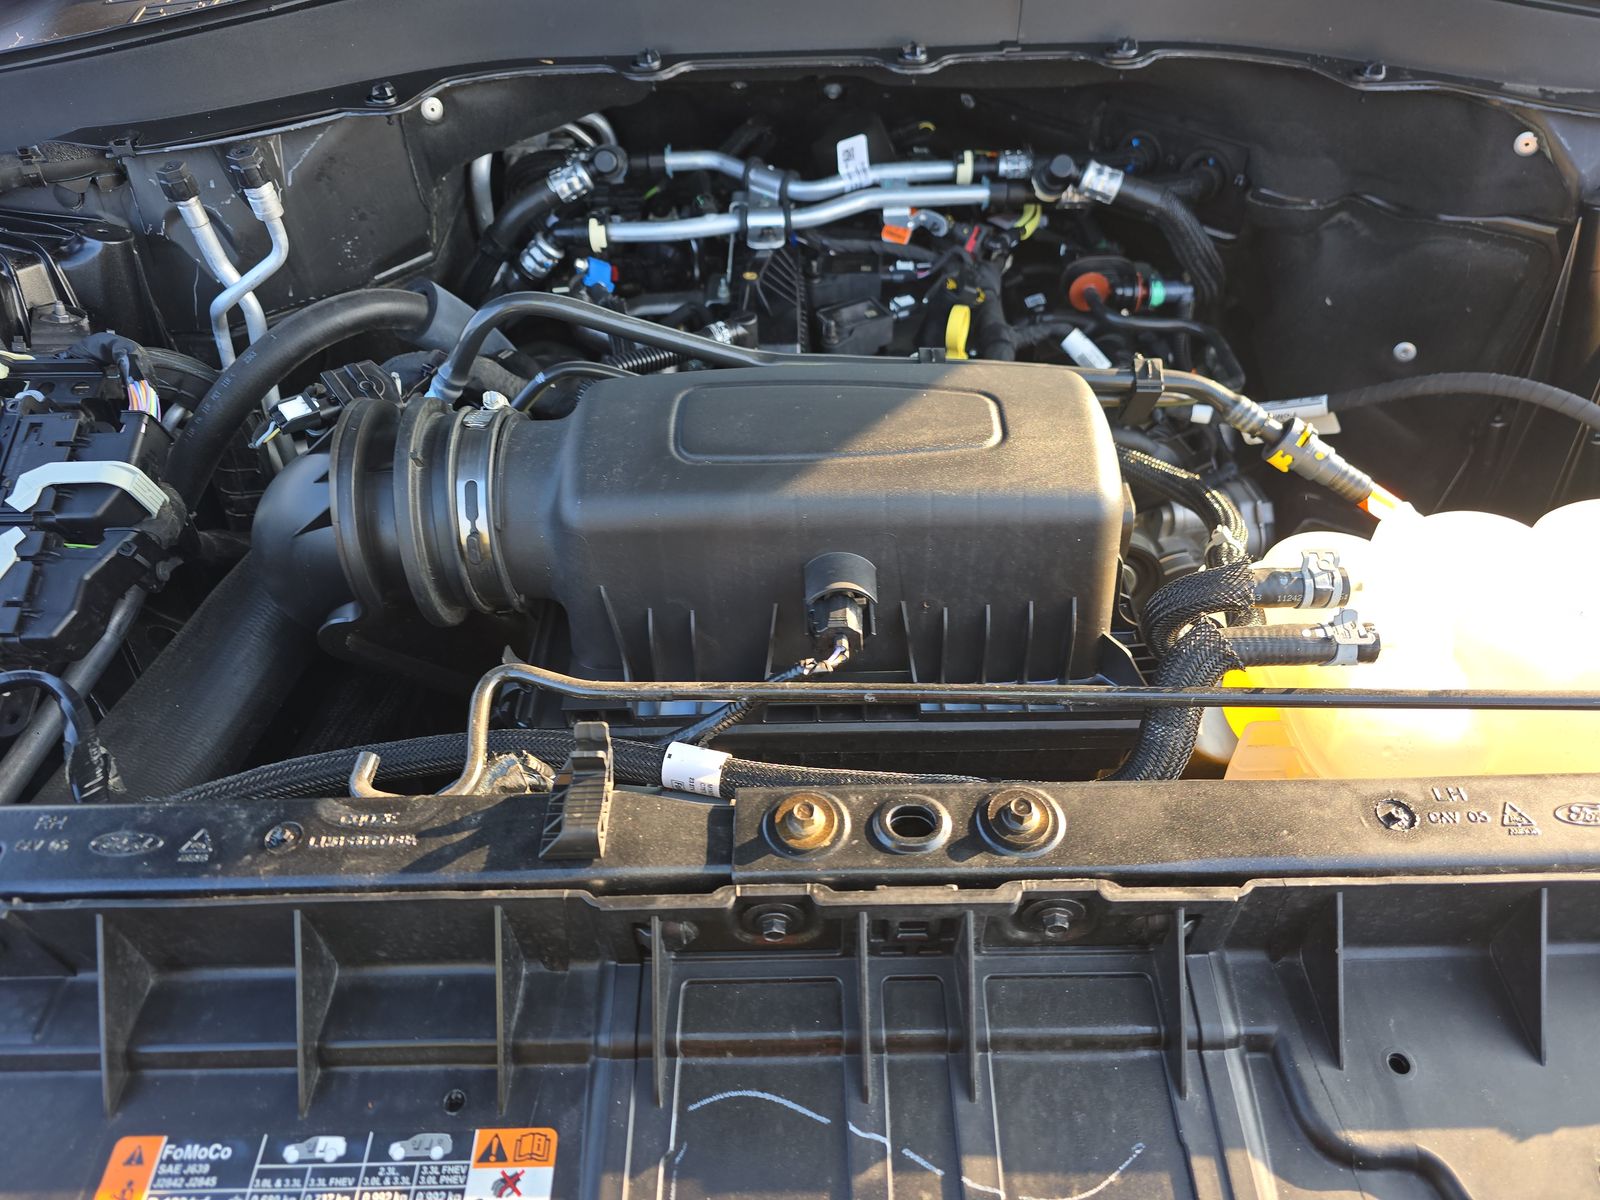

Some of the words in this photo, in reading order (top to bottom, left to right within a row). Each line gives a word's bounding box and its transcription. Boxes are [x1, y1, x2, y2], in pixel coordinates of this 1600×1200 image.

[1431, 787, 1468, 802] LH
[162, 1143, 232, 1161] FoMoCo
[158, 1163, 183, 1175] SAE
